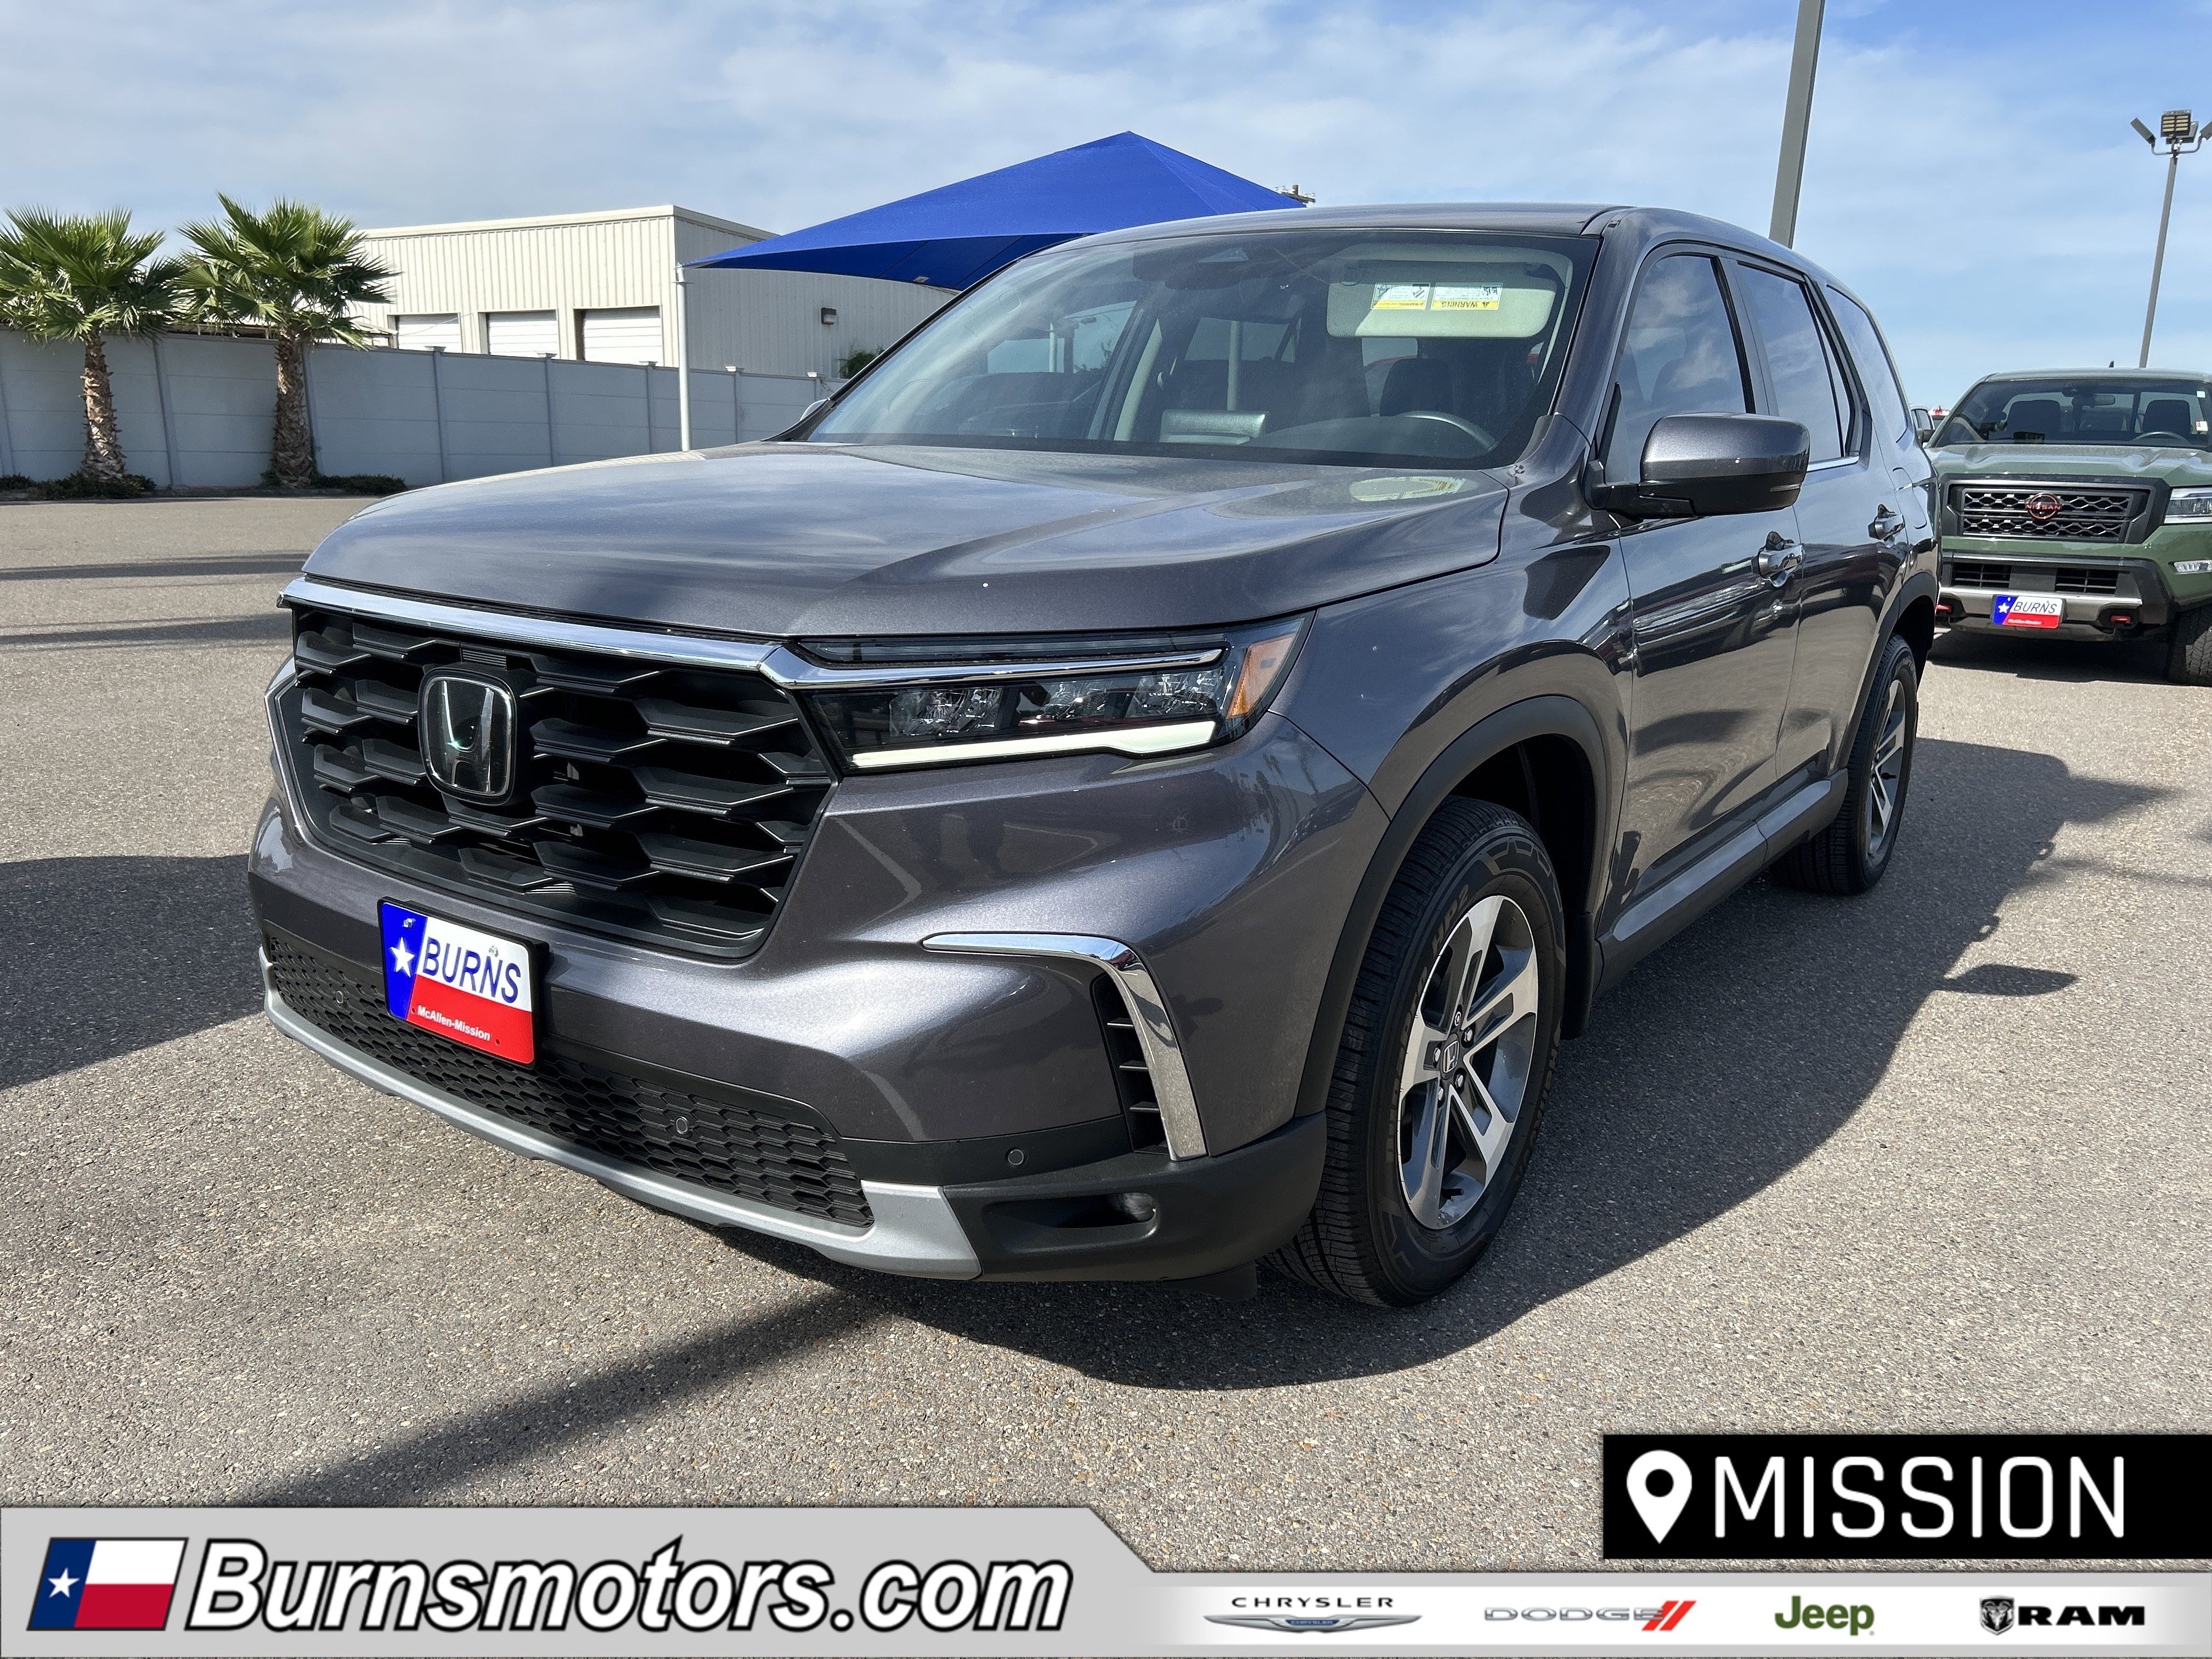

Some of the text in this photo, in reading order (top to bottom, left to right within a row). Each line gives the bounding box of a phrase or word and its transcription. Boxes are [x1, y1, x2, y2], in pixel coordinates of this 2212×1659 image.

[2013, 601, 2057, 613] BURNS
[1432, 882, 1469, 958] HP2
[422, 936, 521, 1003] BURNS
[417, 1005, 490, 1041] McAllen-Mission
